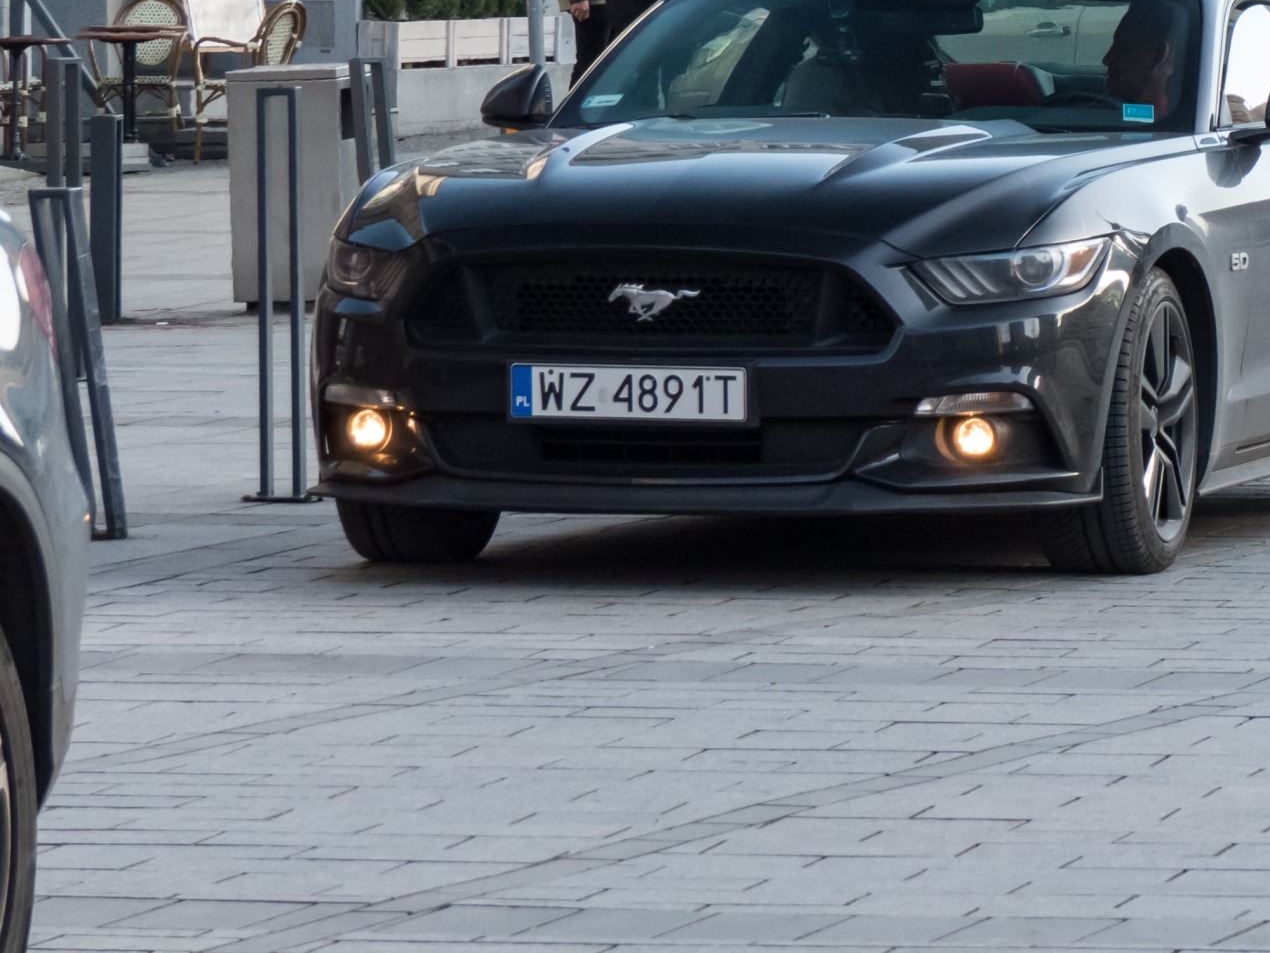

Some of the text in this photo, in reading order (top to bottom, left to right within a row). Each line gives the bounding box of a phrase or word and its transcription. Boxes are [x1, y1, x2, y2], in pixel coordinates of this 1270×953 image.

[516, 396, 530, 407] PL
[539, 370, 737, 415] WZ 4891T
